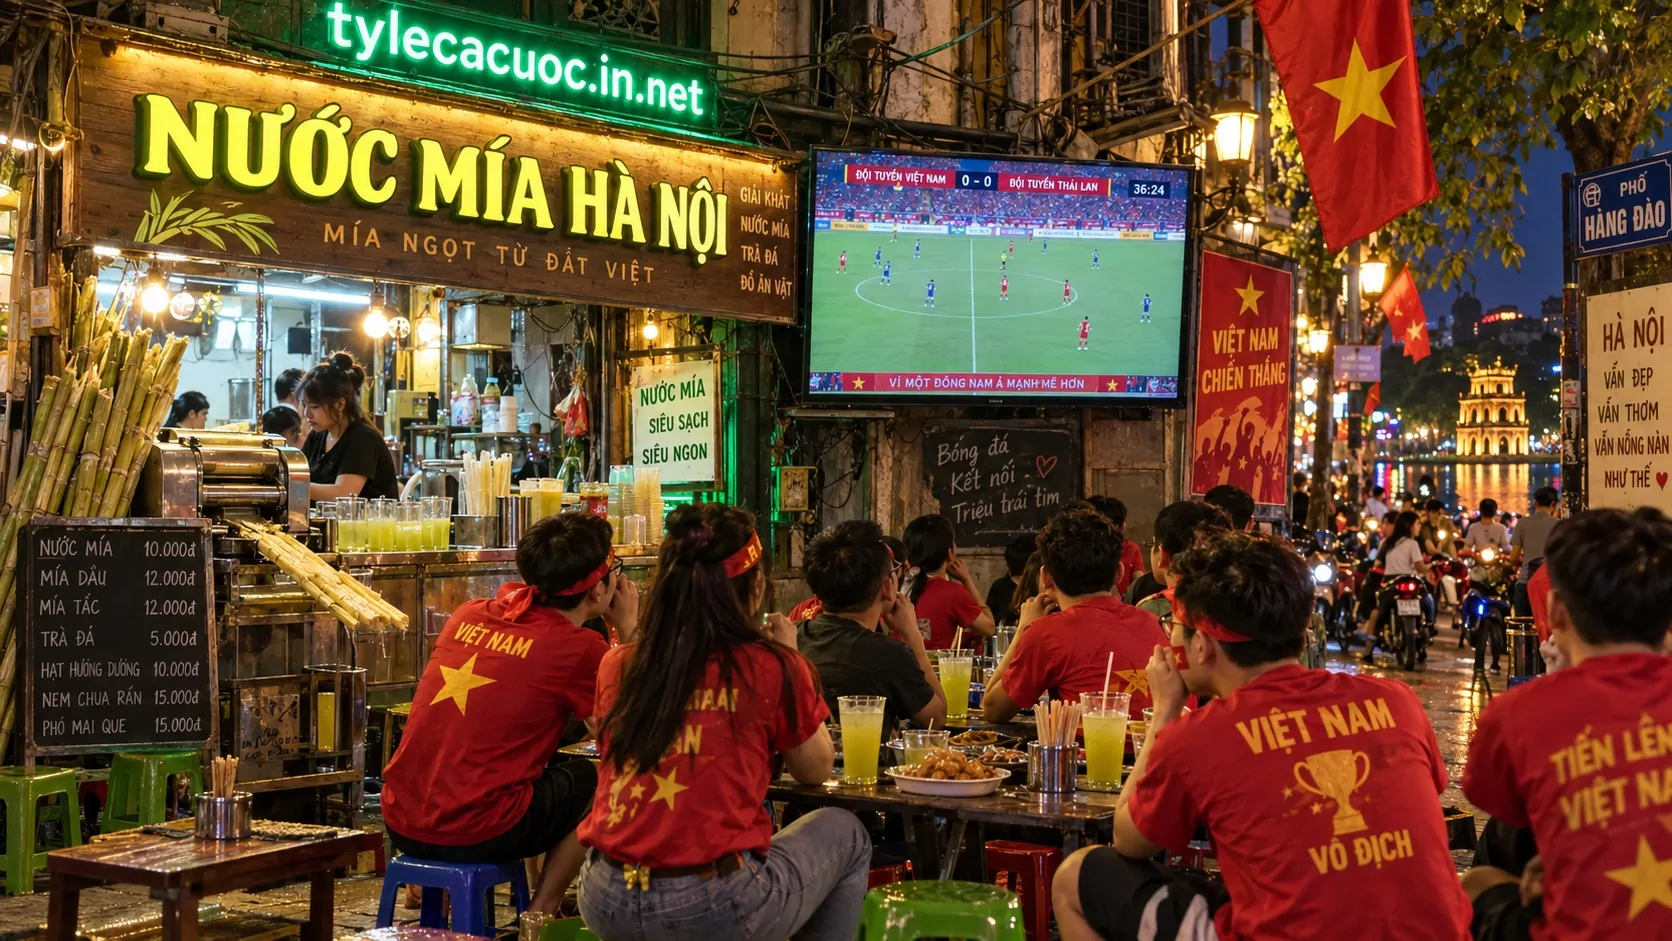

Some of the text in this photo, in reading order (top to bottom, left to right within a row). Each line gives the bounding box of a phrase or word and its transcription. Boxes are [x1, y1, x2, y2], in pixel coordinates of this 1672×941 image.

[326, 2, 704, 116] tylecacuoc.in.net
[133, 93, 728, 265] NƯỚC MÍA HÀ NỘI
[926, 173, 947, 185] NAM
[961, 174, 971, 187] 0
[983, 175, 992, 188] 0
[1080, 181, 1098, 192] LAN
[1133, 184, 1165, 196] 36:24
[1620, 170, 1648, 197] PHỐ
[764, 189, 791, 210] KHÁT
[741, 214, 790, 239] NƯỚC MÍA
[1585, 197, 1666, 241] HÀNG ĐÀO
[323, 220, 381, 248] MÍA
[403, 232, 475, 263] NGỌT
[496, 242, 528, 267] TỪ
[605, 259, 654, 286] VIỆT
[741, 243, 779, 266] TRÀ ĐÁ
[1212, 323, 1279, 358] VIỆT NAM
[1603, 306, 1665, 354] HÀ NỘI
[969, 379, 993, 389] NAM
[1201, 358, 1244, 394] CHIẾN
[1632, 366, 1654, 391] ĐẸP
[640, 373, 706, 407] NƯỚC MÍA
[649, 410, 709, 434] SIÊU SẠCH
[1625, 400, 1659, 422] THƠM
[642, 442, 708, 465] SIÊU NGON
[937, 433, 1009, 467] Bóng đá
[1647, 429, 1669, 455] NÀN
[951, 458, 1016, 496] Kết nối
[1605, 461, 1653, 489] NHƯ THẾ
[951, 486, 1060, 524] Triệu trái tim
[39, 534, 196, 558] NƯỚC MÍA 10.000đ
[40, 564, 69, 587] MÍA
[144, 570, 196, 586] 12.000đ
[39, 594, 66, 616] MÍA
[143, 599, 196, 616] 12.000đ
[40, 625, 197, 648] TRÀ ĐÁ 5.000đ
[454, 622, 534, 659] VIỆT NAM
[41, 661, 64, 681] HẠT
[153, 661, 200, 677] 10.000đ
[42, 685, 200, 709] NEM CHUA RÁN 15.000đ
[71, 719, 95, 735] MAI
[102, 718, 127, 735] QUE
[154, 717, 202, 734] 15.000đ
[1235, 697, 1397, 755] VIỆT NAM
[1549, 723, 1616, 785] TIẾN
[1559, 775, 1628, 831] VIỆT
[1307, 829, 1414, 876] VÔ ĐỊCH
